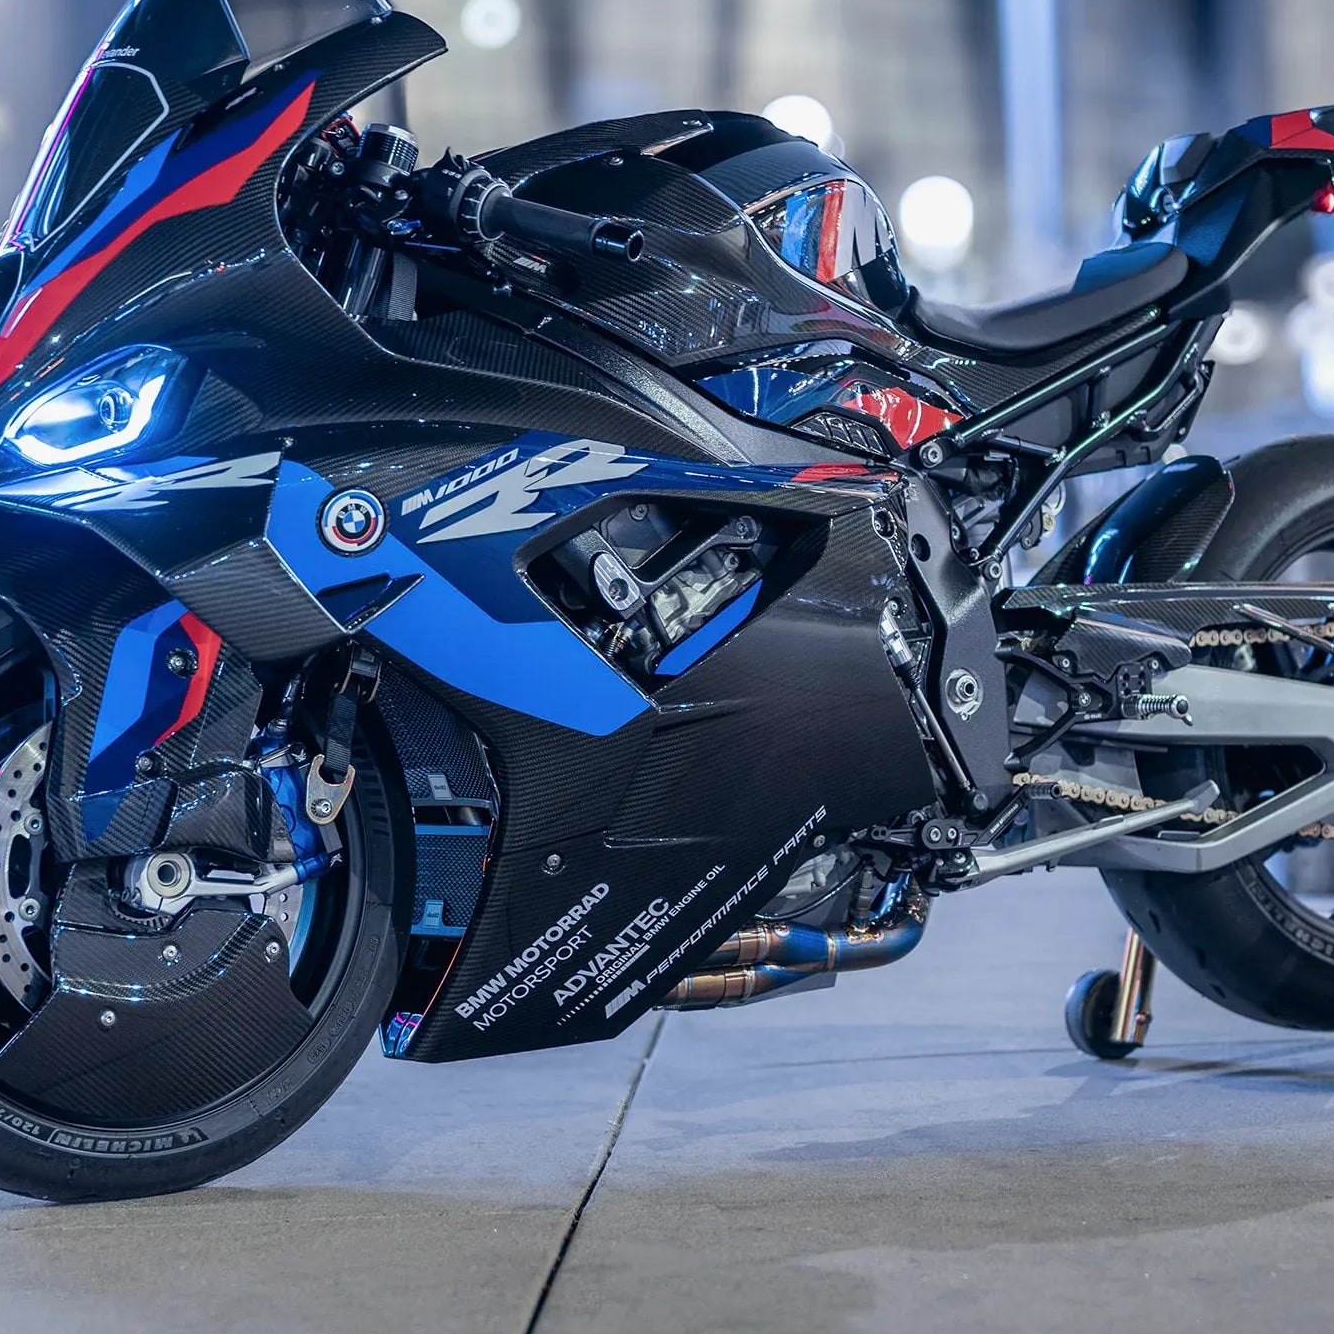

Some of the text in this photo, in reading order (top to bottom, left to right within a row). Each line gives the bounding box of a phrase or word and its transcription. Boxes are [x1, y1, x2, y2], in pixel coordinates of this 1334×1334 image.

[337, 504, 369, 519] BMW
[596, 864, 726, 984] ORIGINAL BMW ENGINE OIL
[646, 865, 769, 984] PERFORMANCE
[773, 805, 827, 866] PARTS
[455, 883, 610, 1018] BMW MOTORRAD
[473, 925, 592, 1031] MOTORSPORT
[553, 898, 670, 1007] ADVANTEC
[54, 1132, 173, 1153] MICHELIN
